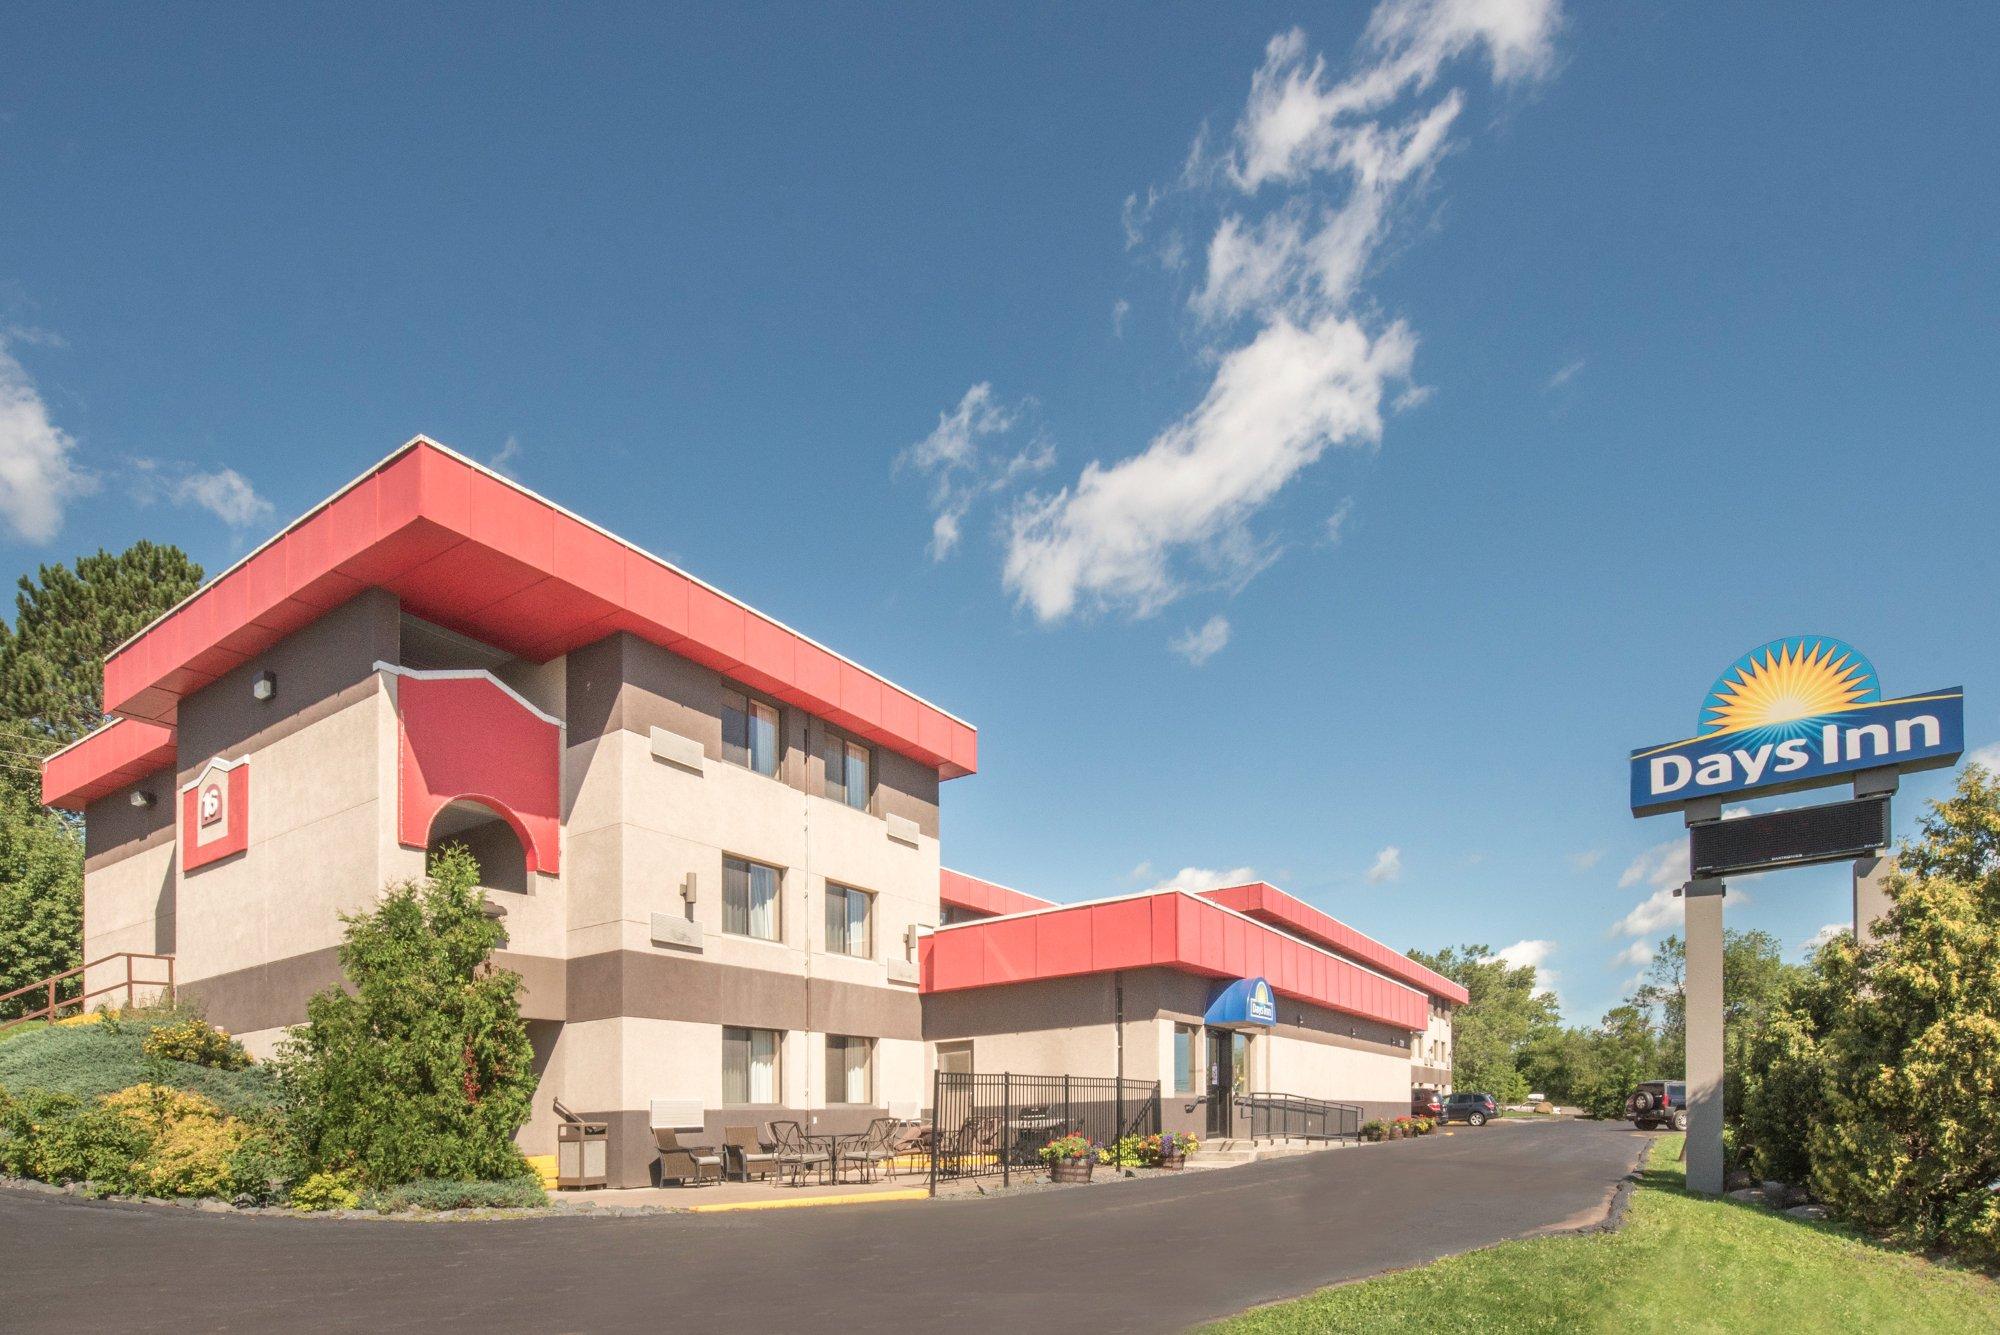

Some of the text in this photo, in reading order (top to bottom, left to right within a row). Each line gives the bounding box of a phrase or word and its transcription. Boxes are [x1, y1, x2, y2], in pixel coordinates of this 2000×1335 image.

[1650, 714, 1941, 795] Days Inn
[1252, 1003, 1263, 1015] Days
